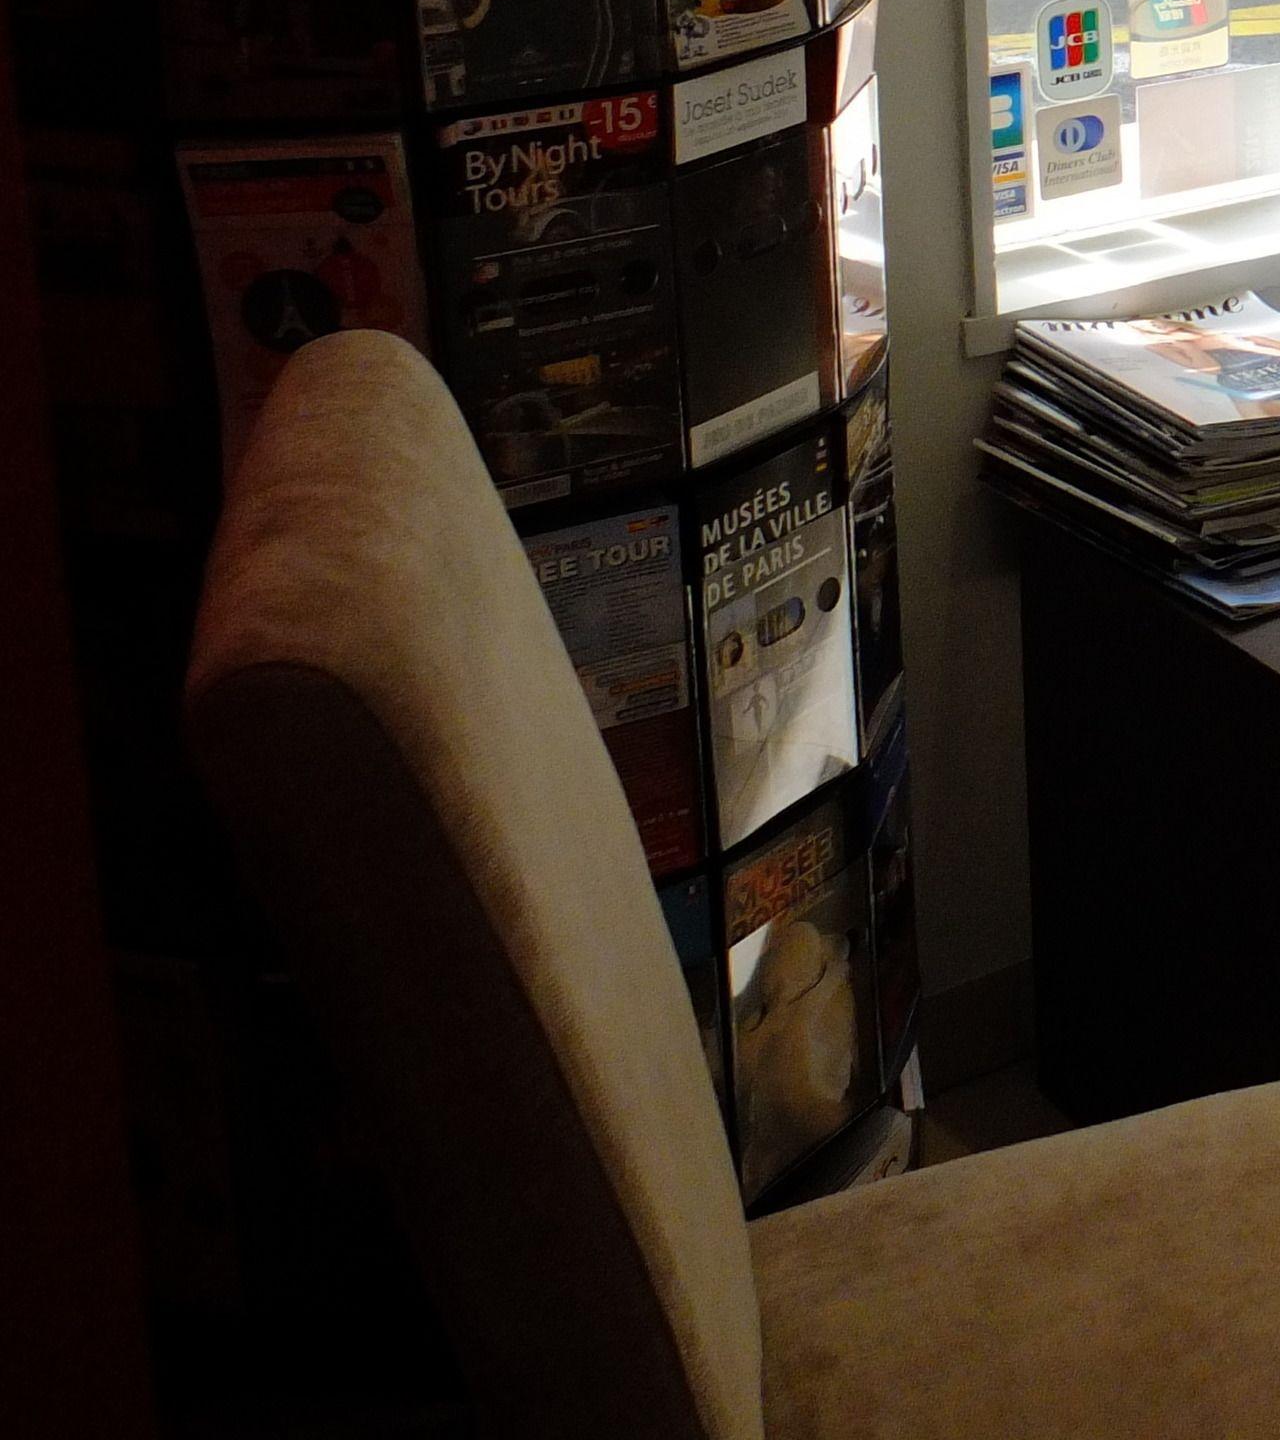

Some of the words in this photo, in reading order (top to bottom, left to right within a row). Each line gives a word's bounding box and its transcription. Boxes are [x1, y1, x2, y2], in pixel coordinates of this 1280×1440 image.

[1050, 30, 1098, 49] JCB
[681, 88, 733, 125] Josef
[737, 69, 797, 106] Sudek
[1050, 72, 1080, 86] JCB
[589, 97, 644, 134] -15
[465, 150, 507, 187] By
[512, 133, 603, 175] Night
[1044, 161, 1119, 187] International
[1046, 157, 1085, 174] Diners
[1088, 150, 1116, 165] Club
[464, 179, 560, 214] Tours
[703, 480, 792, 547] MUSÉES
[704, 541, 733, 577] DE
[738, 523, 766, 556] LA
[770, 491, 830, 539] VILLE
[590, 536, 672, 570] TOUR
[707, 570, 736, 608] DE
[742, 535, 806, 588] PARIS
